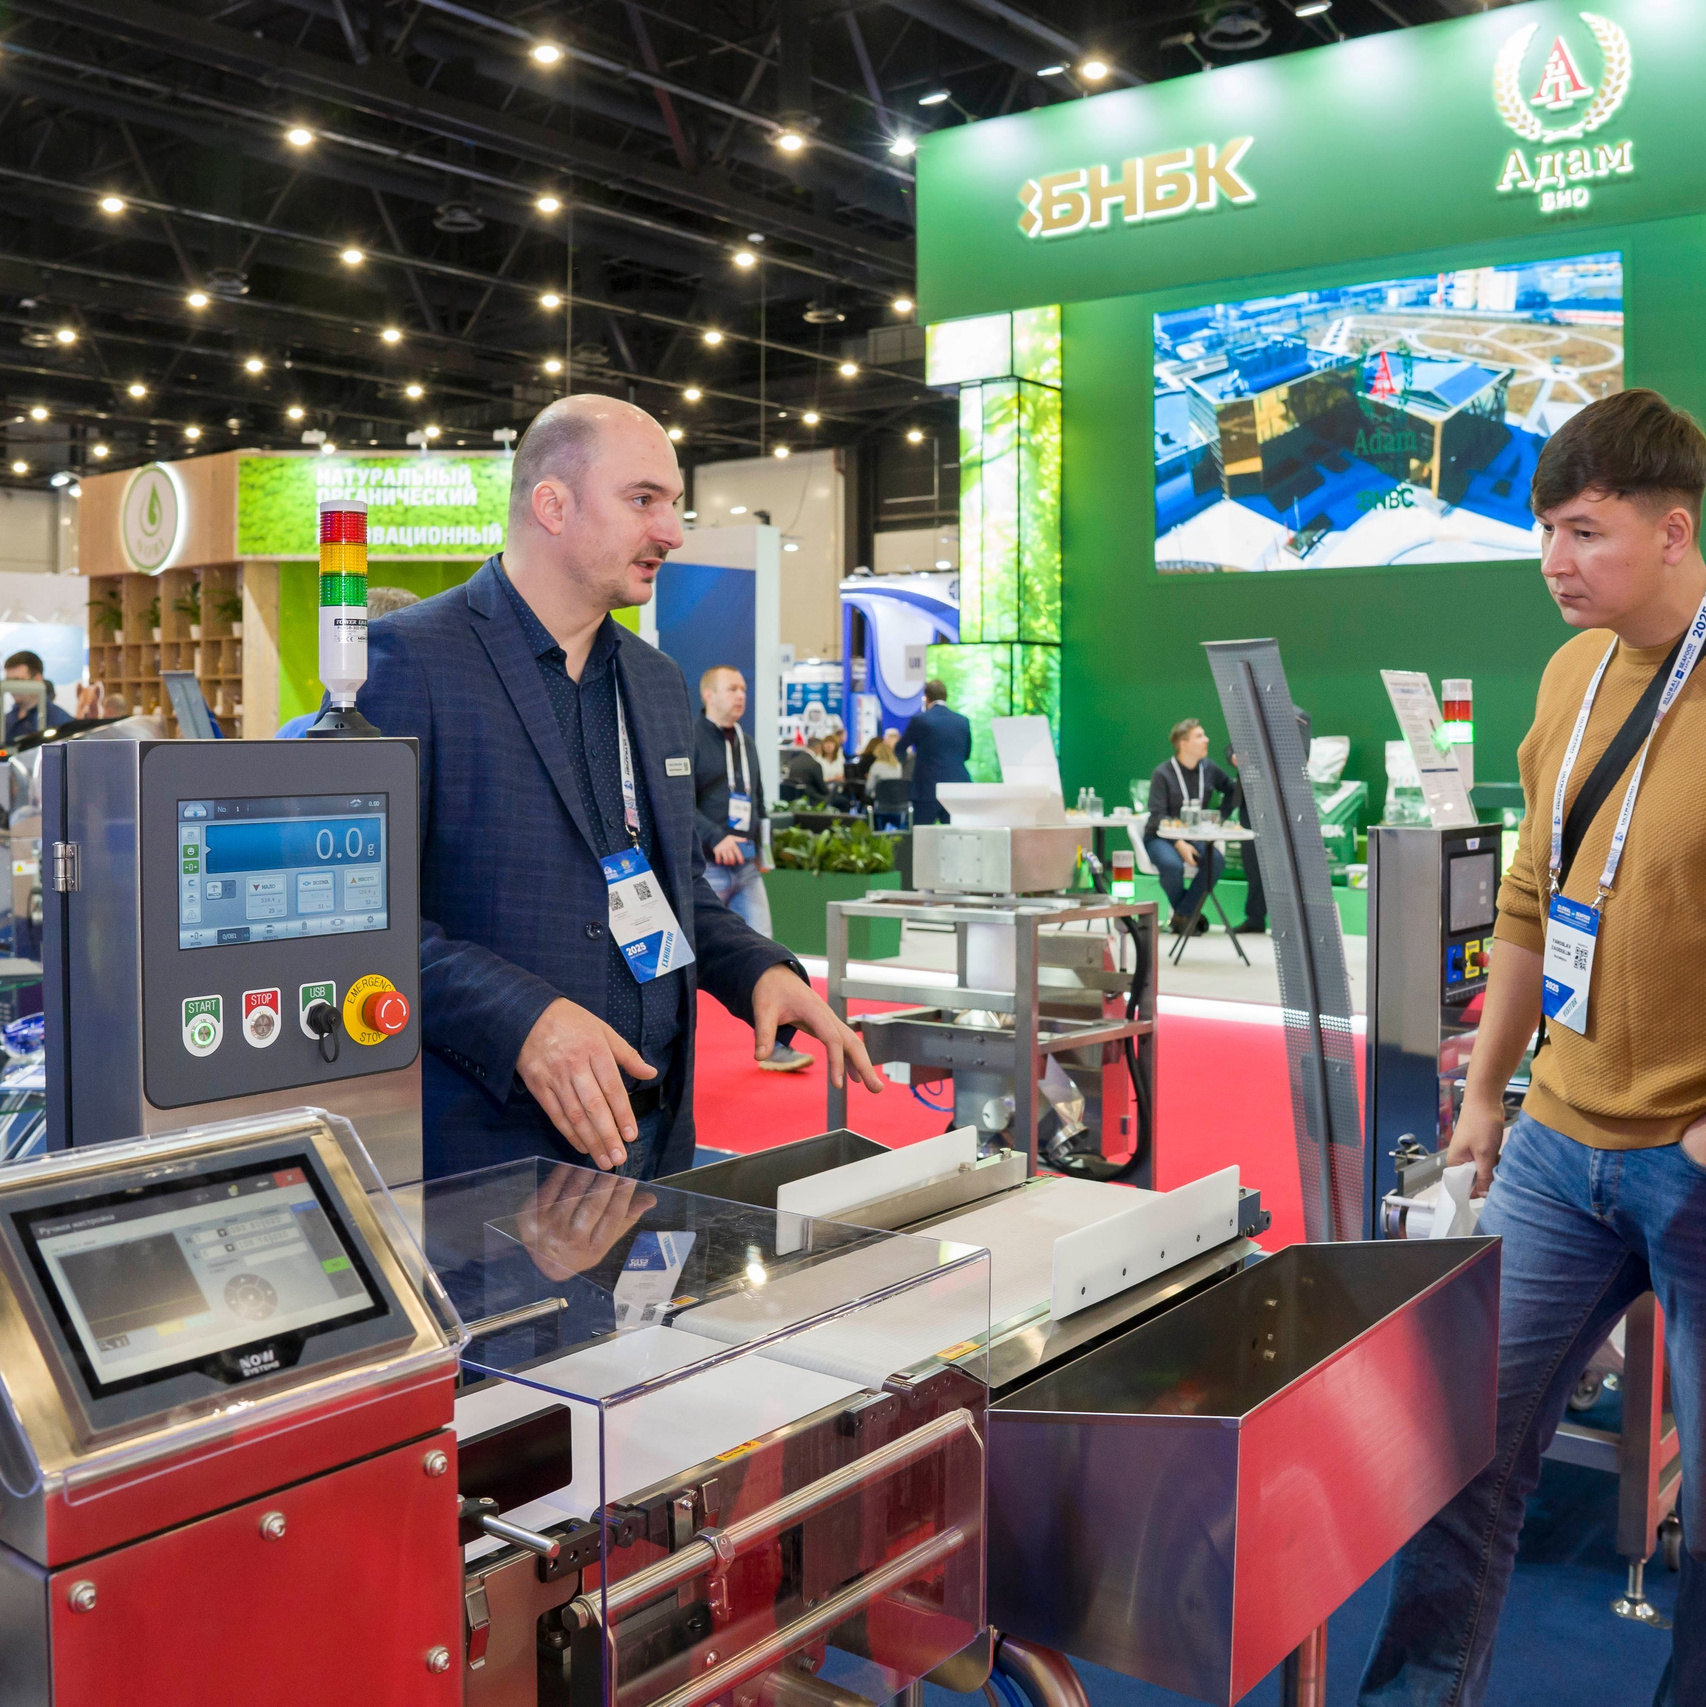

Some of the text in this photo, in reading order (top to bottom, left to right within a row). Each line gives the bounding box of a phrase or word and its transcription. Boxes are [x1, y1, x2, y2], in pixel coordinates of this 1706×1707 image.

[1496, 140, 1634, 192] Адам
[1039, 136, 1256, 237] БНБК
[1354, 427, 1418, 455] Adam
[316, 465, 473, 487] НАТУРАЛЬНЫЙ
[316, 484, 478, 506] ОРГАНИЧЕСКИЙ
[1678, 643, 1694, 669] SEAFOOD
[316, 827, 375, 860] 0.0 g
[625, 942, 647, 956] 2025
[661, 931, 674, 968] EXHIBITOR
[309, 986, 326, 998] USB
[346, 976, 394, 1005] EMERGENC
[1545, 979, 1560, 993] 2025
[188, 1000, 217, 1014] START
[250, 993, 273, 1005] STOP
[243, 1361, 280, 1377] SYSTEMS
